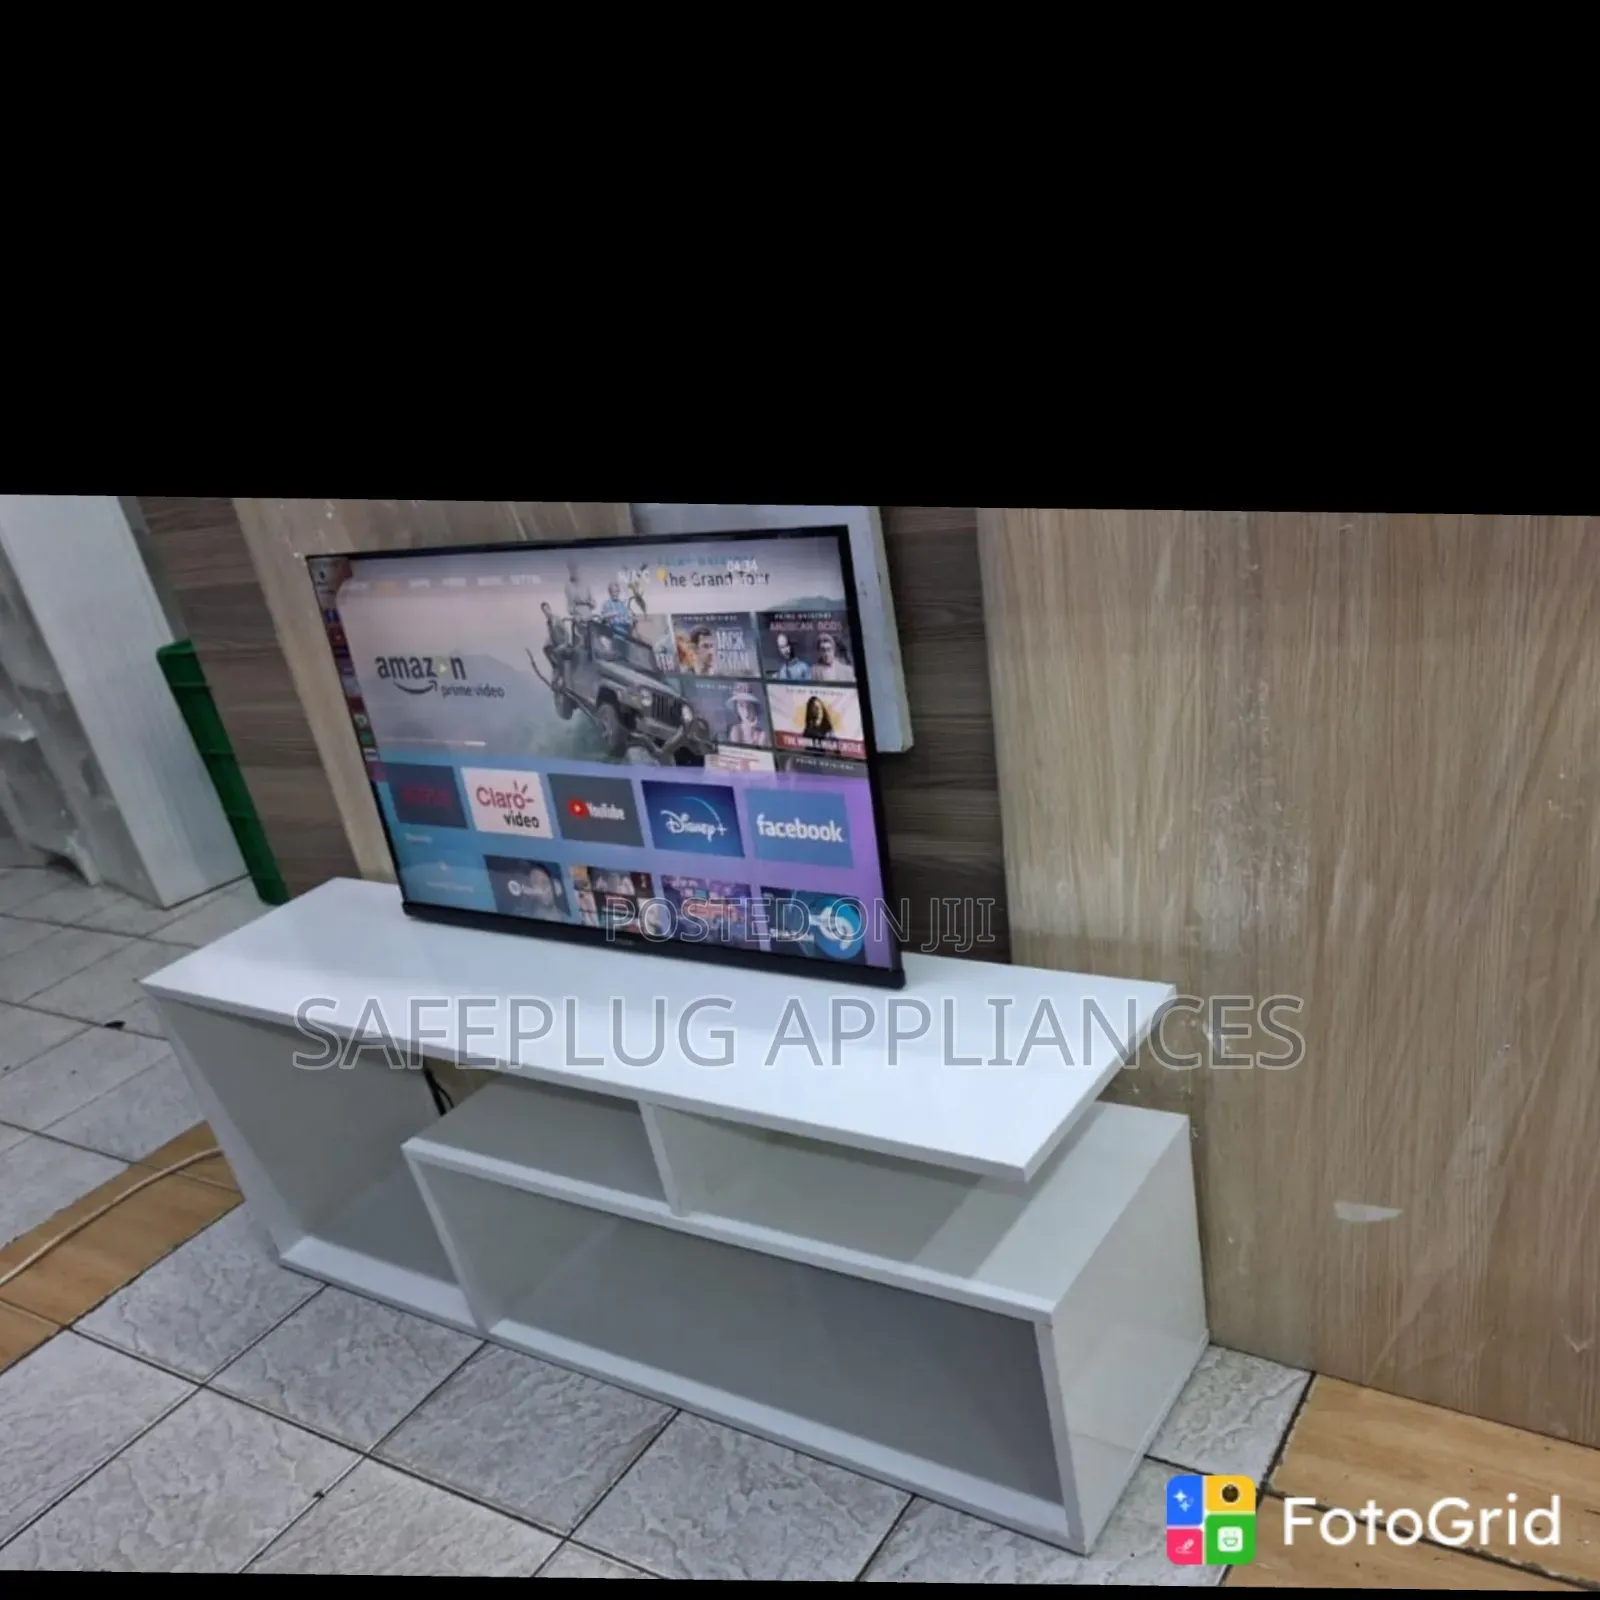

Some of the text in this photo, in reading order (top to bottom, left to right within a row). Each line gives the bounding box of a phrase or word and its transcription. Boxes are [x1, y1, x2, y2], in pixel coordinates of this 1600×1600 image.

[691, 571, 733, 588] Grand
[375, 655, 467, 681] amazn
[441, 682, 506, 699] prime video
[475, 785, 527, 810] Claro
[585, 801, 626, 820] YouTube
[503, 812, 541, 829] video
[755, 813, 845, 844] facebook
